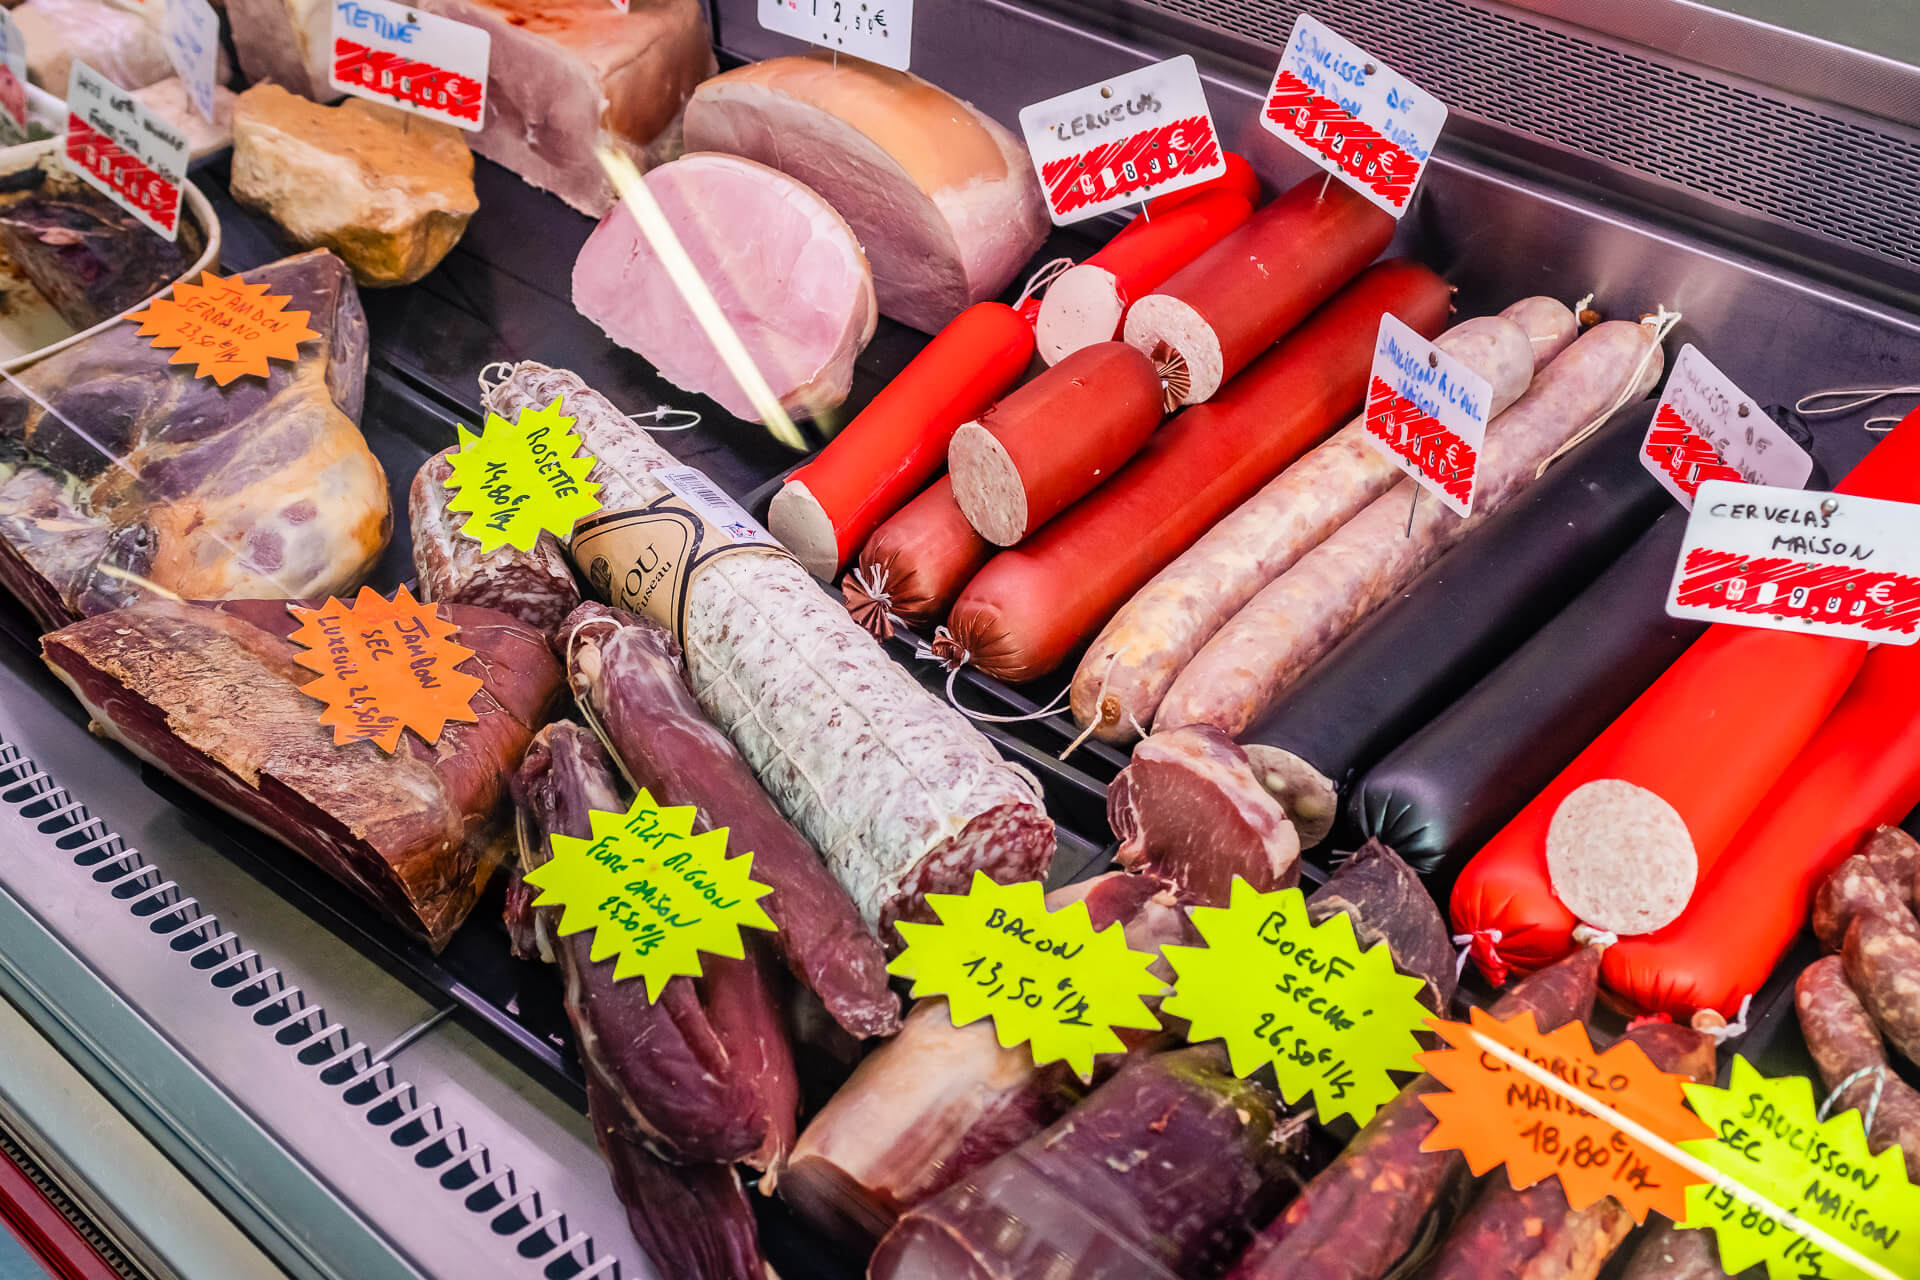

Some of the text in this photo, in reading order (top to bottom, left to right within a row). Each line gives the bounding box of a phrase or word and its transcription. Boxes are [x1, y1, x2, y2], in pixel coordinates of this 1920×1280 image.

[526, 426, 579, 499] ROSETTE
[1710, 502, 1832, 530] CERVELAS
[360, 629, 395, 662] SEC
[984, 908, 1084, 960] BACON
[1256, 911, 1356, 983] BOEUF
[1717, 1119, 1762, 1163] SEC
